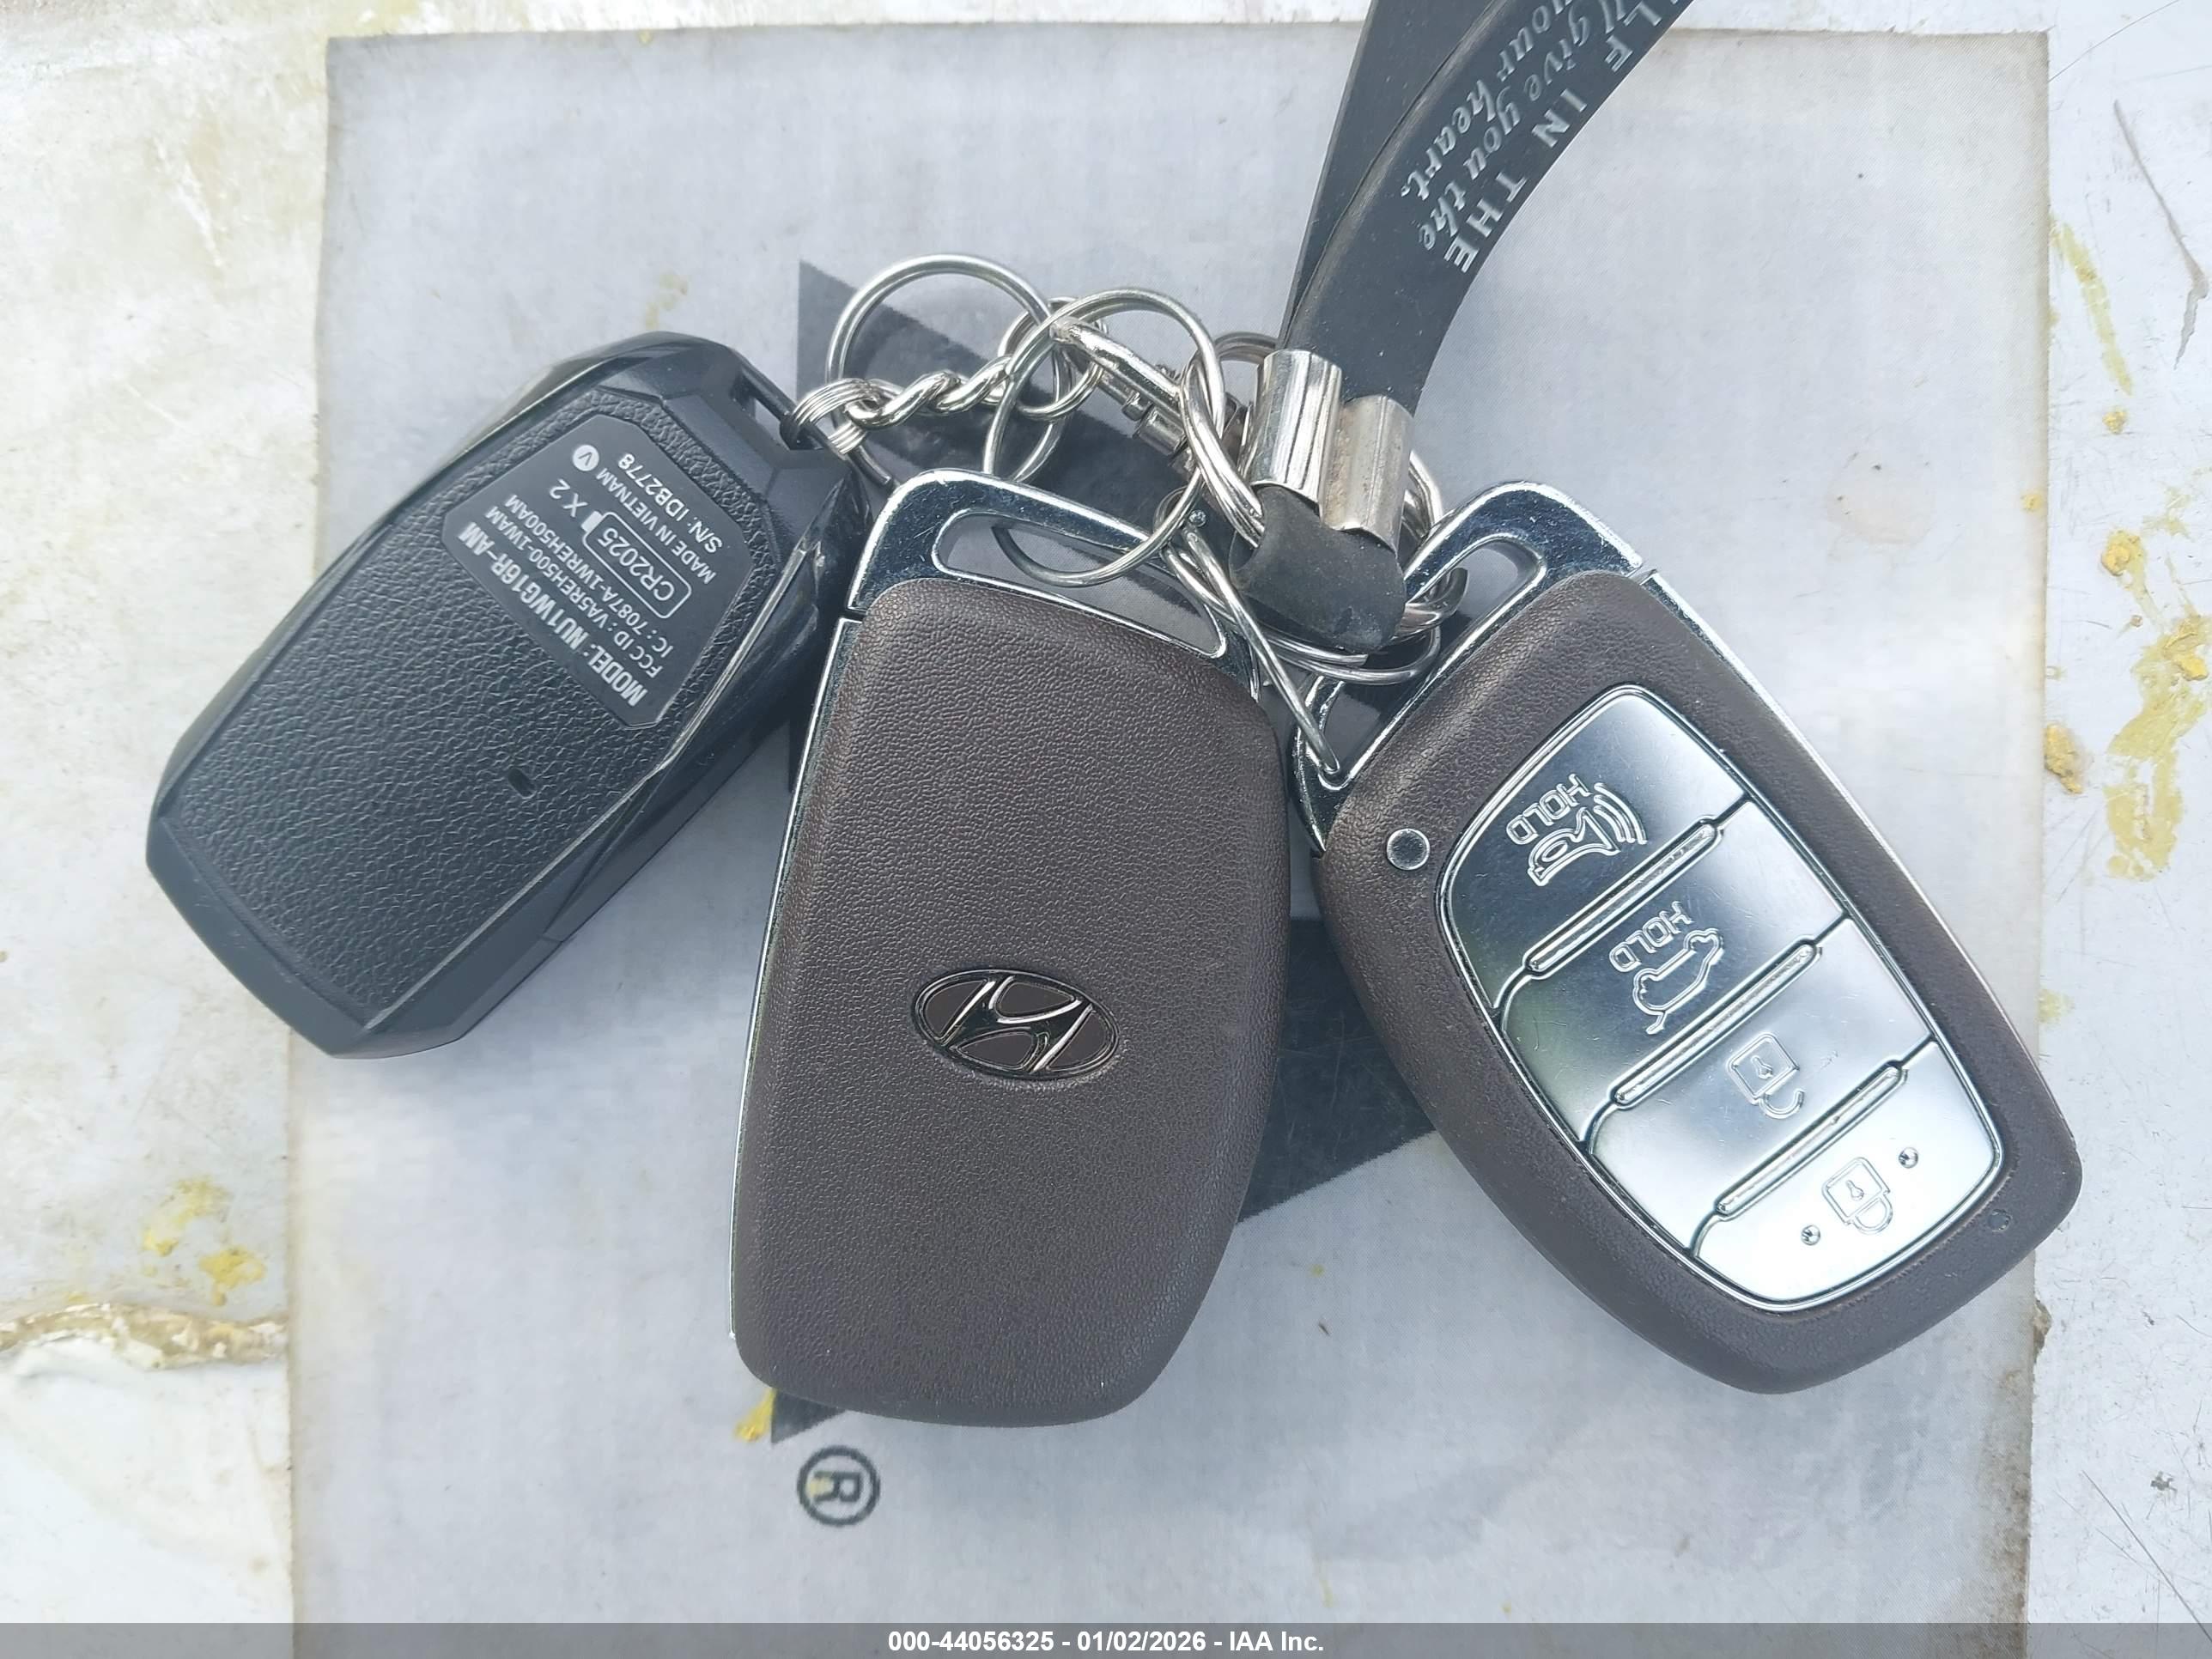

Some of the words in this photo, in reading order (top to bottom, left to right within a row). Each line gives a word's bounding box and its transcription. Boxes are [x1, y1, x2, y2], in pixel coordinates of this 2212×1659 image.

[1524, 3, 1590, 101] give
[1604, 0, 1679, 72] LF
[1401, 79, 1496, 201] heart.
[1462, 86, 1521, 180] you
[1531, 88, 1587, 148] IN
[1419, 181, 1467, 251] the
[1443, 172, 1528, 273] THE
[549, 478, 571, 500] 2
[595, 467, 659, 531] VIETNAM
[617, 453, 690, 521] IDB2778
[484, 505, 609, 629] VA5REH500-1WAM
[504, 494, 648, 635] 7087A-1WREH500AM
[597, 527, 675, 601] CR2025
[654, 525, 677, 546] IN
[671, 540, 716, 584] MADE
[687, 516, 723, 553] S/N:
[457, 521, 589, 650] NU1WG16R-AM
[583, 643, 648, 707] MODEL:
[613, 630, 635, 651] ID
[629, 645, 663, 678] FCC
[651, 636, 674, 658] IC
[1506, 774, 1590, 845] HOLD
[1609, 901, 1693, 973] HOLD
